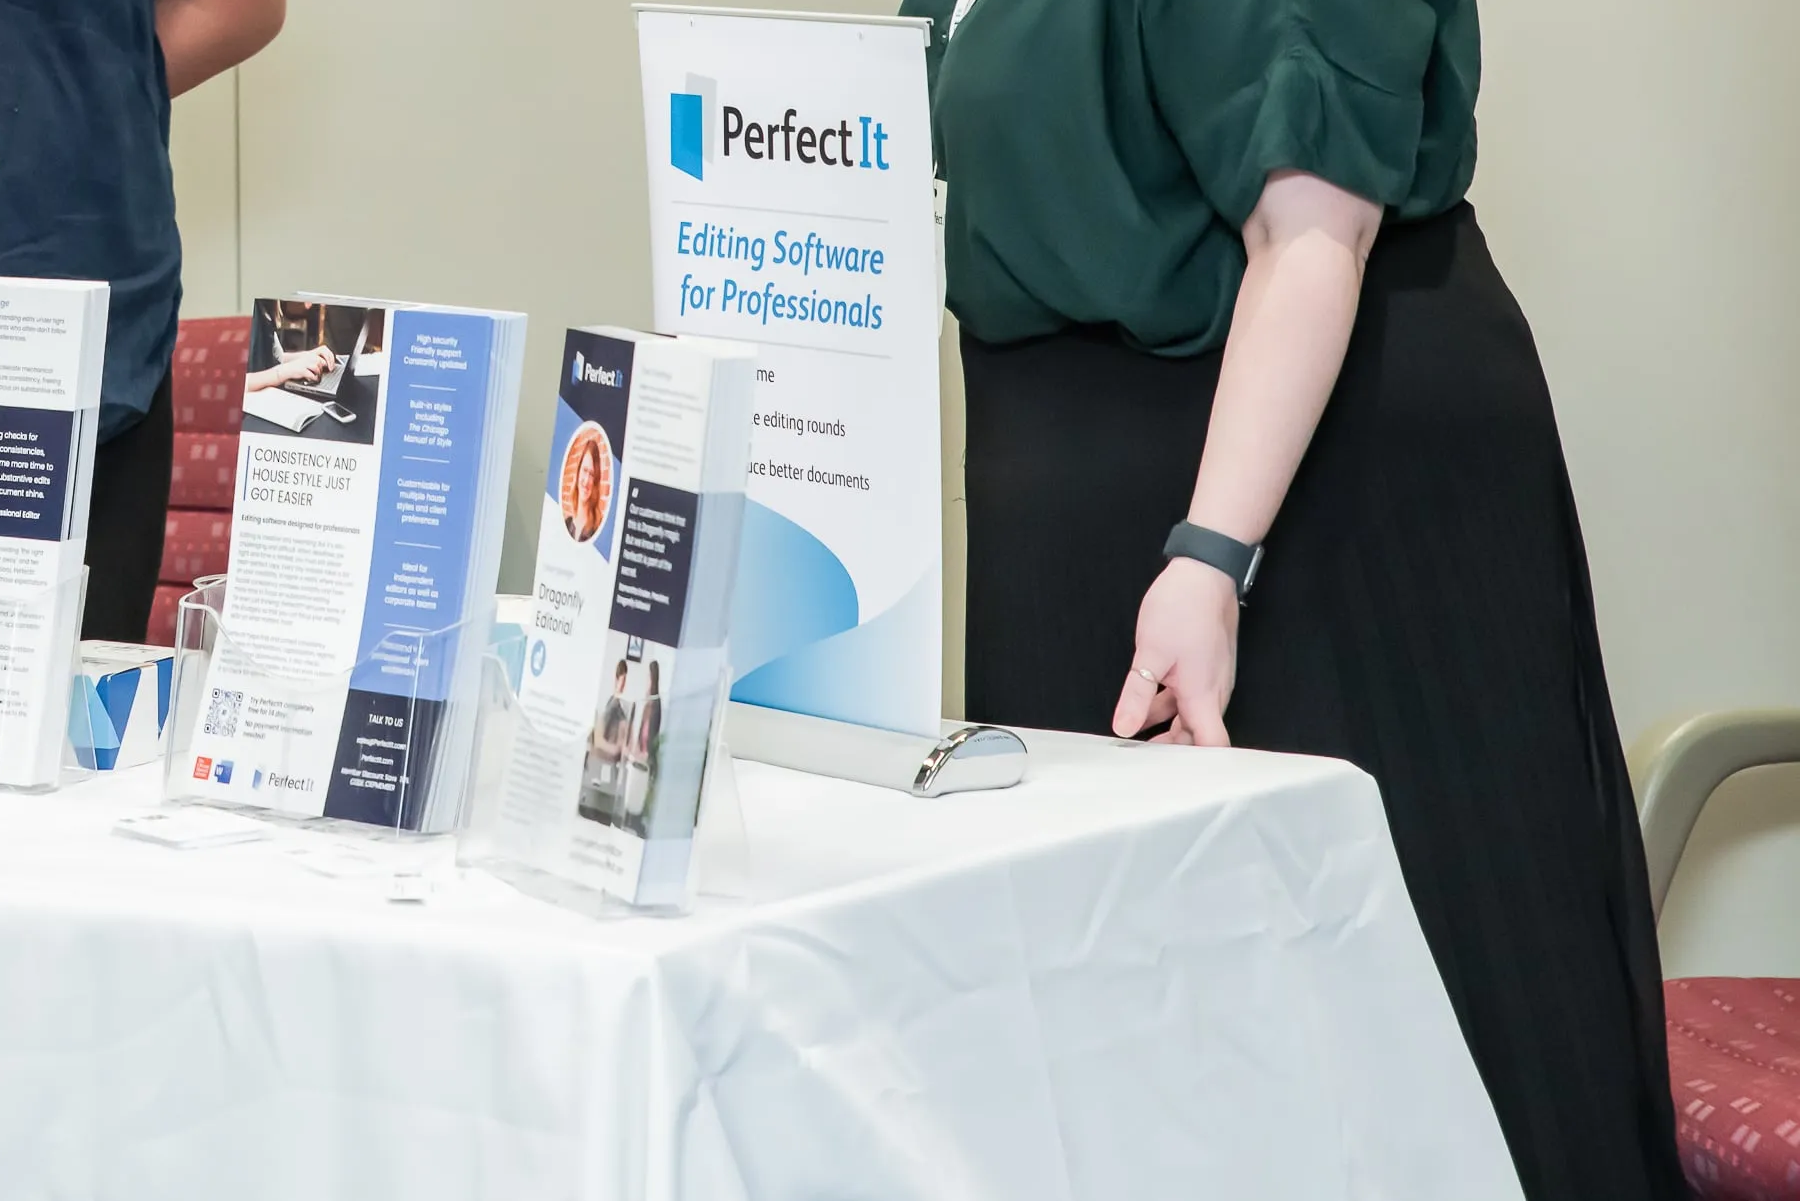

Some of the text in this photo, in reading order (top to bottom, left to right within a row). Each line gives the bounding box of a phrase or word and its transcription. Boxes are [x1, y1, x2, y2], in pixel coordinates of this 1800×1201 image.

[723, 106, 889, 170] PerfectIt
[677, 222, 884, 275] Editing Software
[681, 274, 883, 330] for Professionals
[585, 363, 623, 388] PerfectIt
[757, 369, 775, 382] me
[409, 423, 449, 436] The Chicago
[764, 411, 803, 436] editing
[808, 419, 845, 437] rounds
[4, 431, 27, 440] checks
[29, 433, 38, 441] for
[11, 461, 28, 469] more
[30, 461, 45, 470] time
[46, 463, 53, 471] to
[255, 448, 357, 471] CONSISTENCY AND
[34, 476, 50, 485] edits
[253, 468, 351, 490] HOUSE STYLE JUST
[748, 459, 870, 490] uce better documents
[251, 488, 313, 506] GOT EASIER
[23, 511, 40, 519] Editor
[242, 515, 261, 524] Editing
[263, 517, 286, 525] software
[288, 519, 314, 530] designed
[539, 583, 585, 615] Dragonfly
[536, 611, 573, 635] Editorial
[248, 706, 258, 714] free
[250, 697, 258, 705] Try
[254, 722, 280, 731] payment
[369, 714, 403, 727] TALK TO US
[268, 772, 314, 792] PerfectIt
